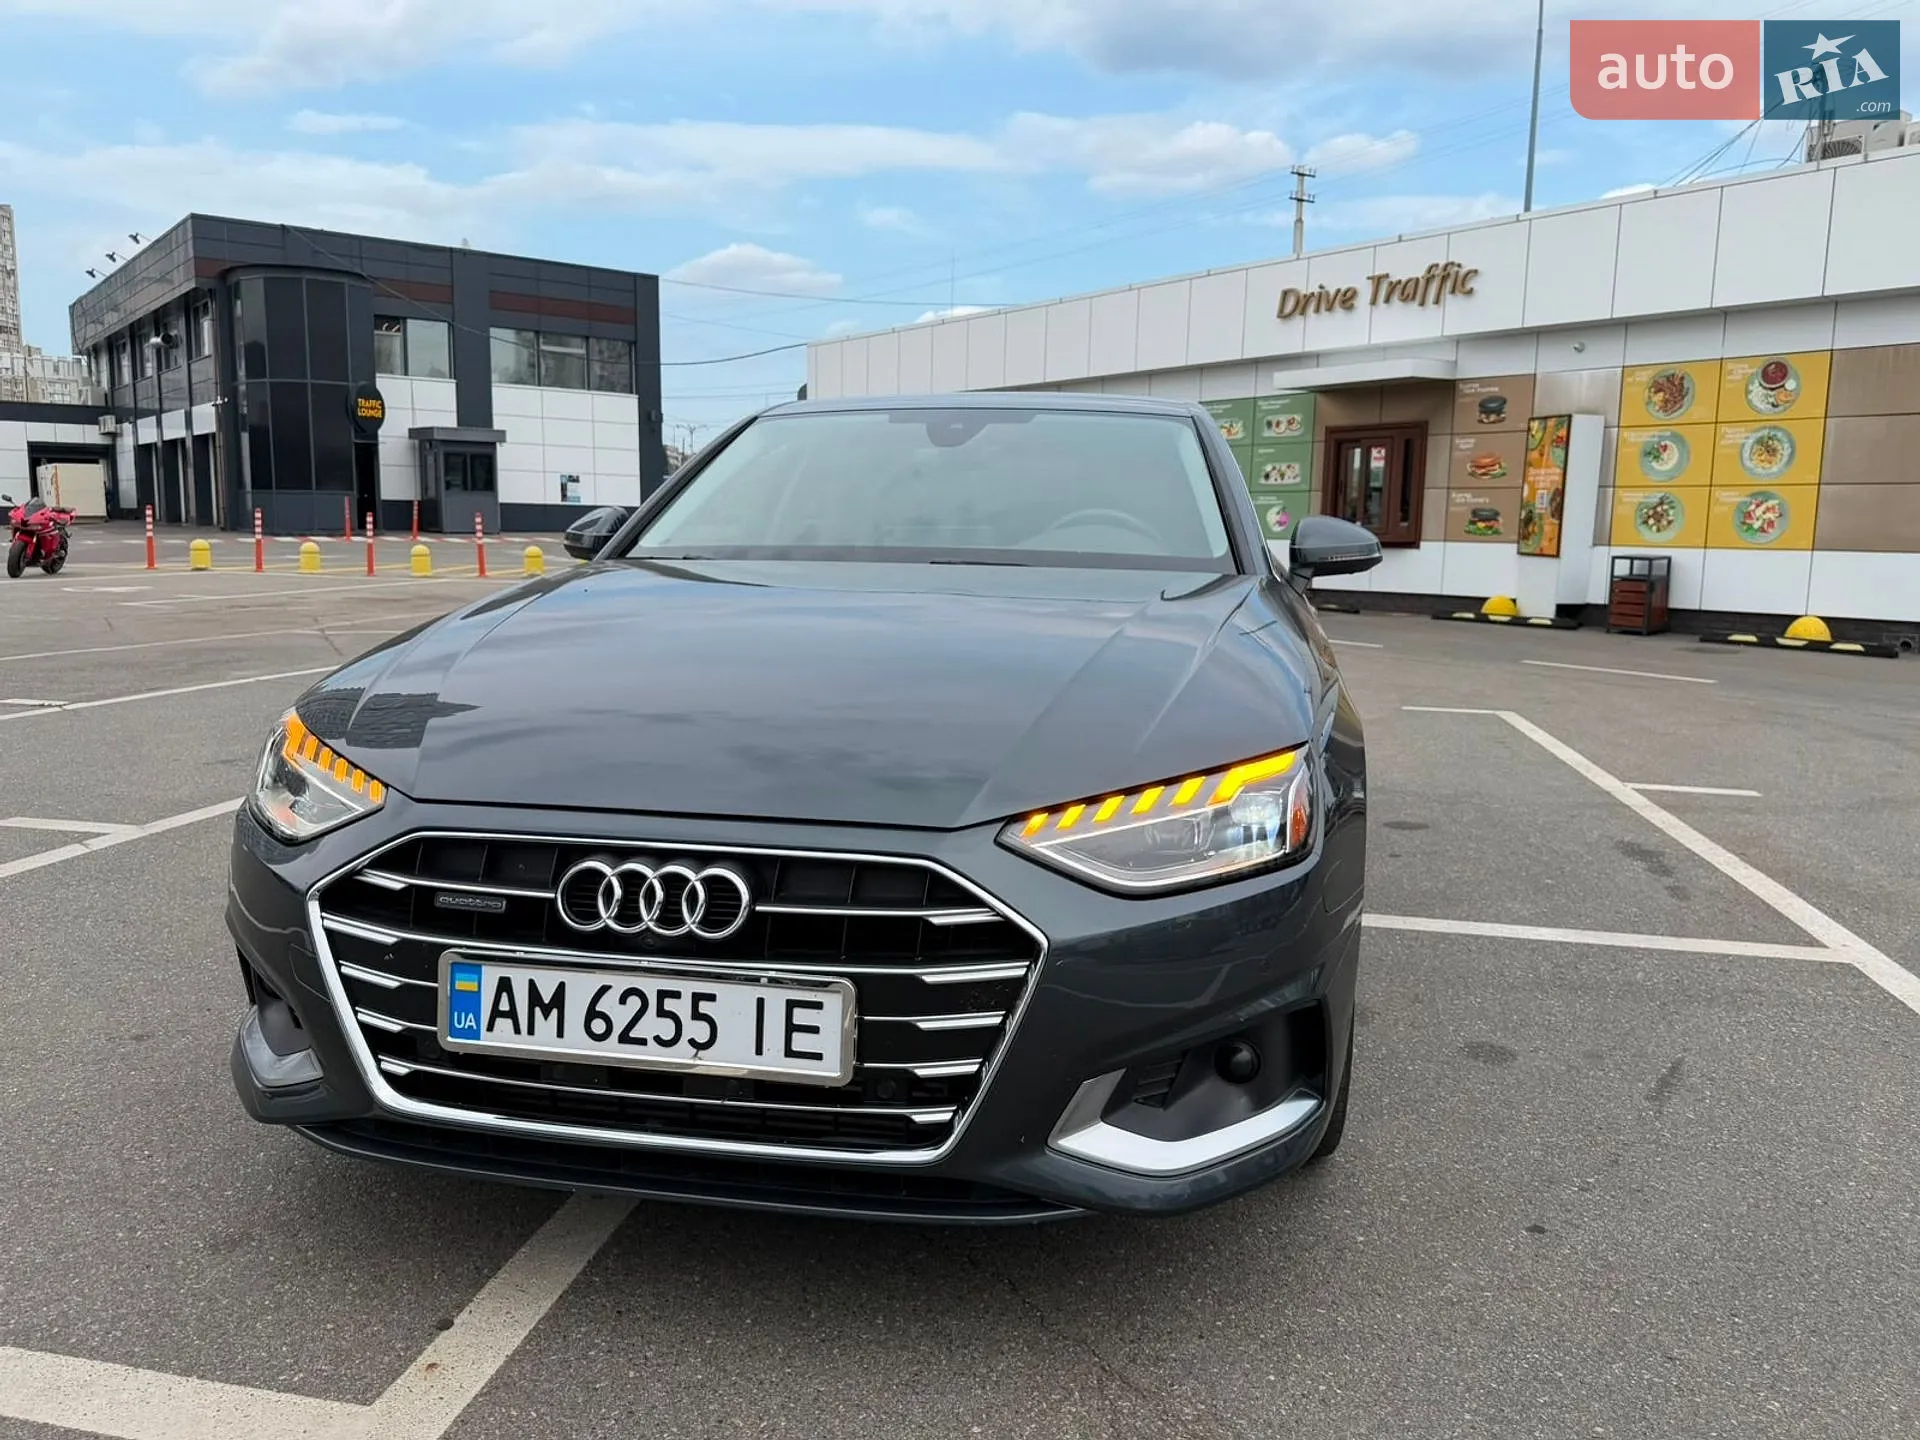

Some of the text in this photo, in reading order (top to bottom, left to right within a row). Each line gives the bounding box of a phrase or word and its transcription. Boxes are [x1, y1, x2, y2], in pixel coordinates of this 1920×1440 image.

[1276, 259, 1480, 320] Drive Traffic
[357, 398, 383, 409] TRAFFIC
[357, 407, 383, 419] LOUNGE
[454, 1011, 477, 1030] UA
[486, 975, 824, 1061] AM 6255 IE
